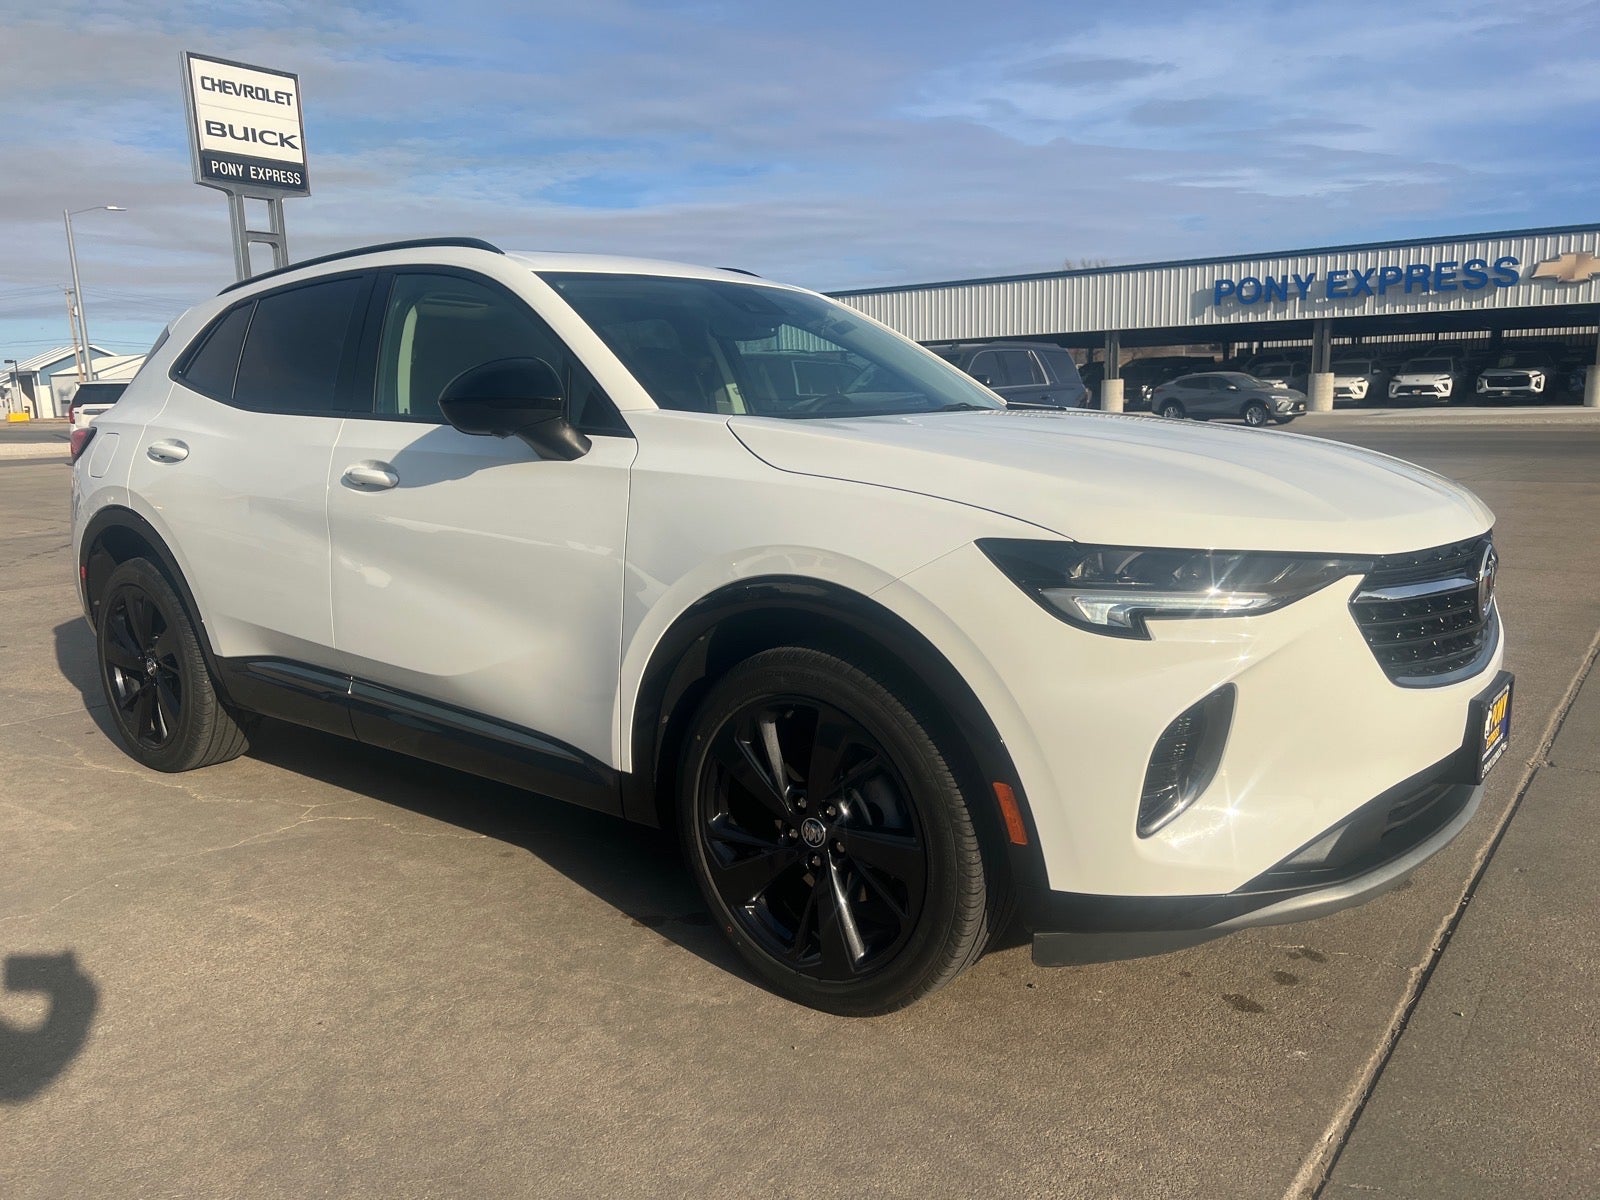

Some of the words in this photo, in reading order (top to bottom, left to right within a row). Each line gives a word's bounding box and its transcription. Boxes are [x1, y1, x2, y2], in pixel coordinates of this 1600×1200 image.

[200, 75, 293, 106] CHEVROLET
[205, 119, 300, 150] BUICK
[211, 160, 244, 177] PONY
[249, 166, 301, 185] EXPRESS
[1214, 273, 1315, 306] PONY
[1326, 256, 1520, 299] EXPRESS
